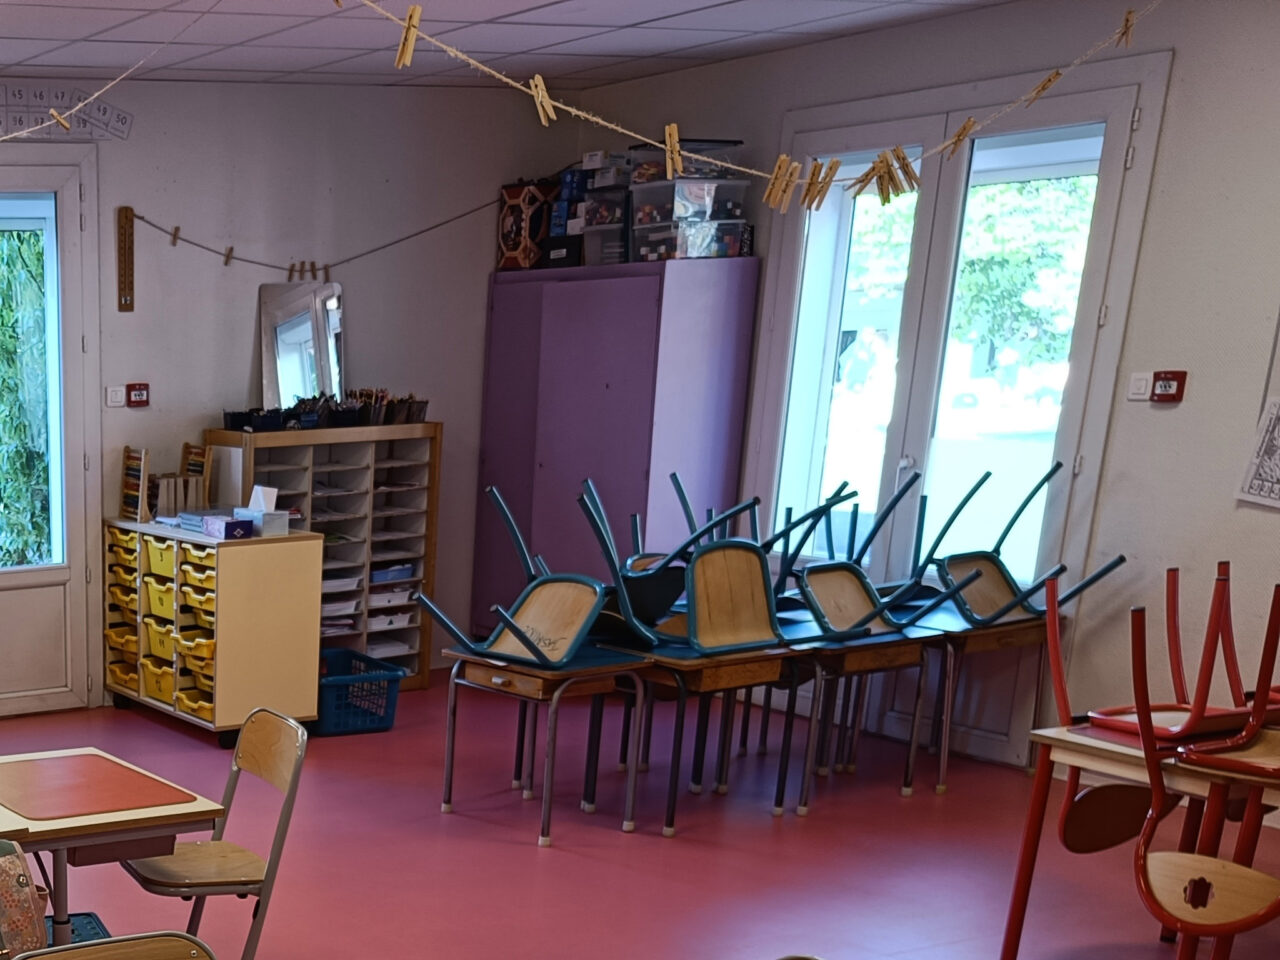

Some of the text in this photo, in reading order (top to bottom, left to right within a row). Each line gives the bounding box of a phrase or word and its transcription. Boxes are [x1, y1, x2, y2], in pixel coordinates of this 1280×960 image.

[11, 89, 23, 99] 45
[33, 90, 44, 100] 46
[54, 91, 65, 101] 47
[96, 105, 107, 116] 49
[115, 114, 127, 126] 50
